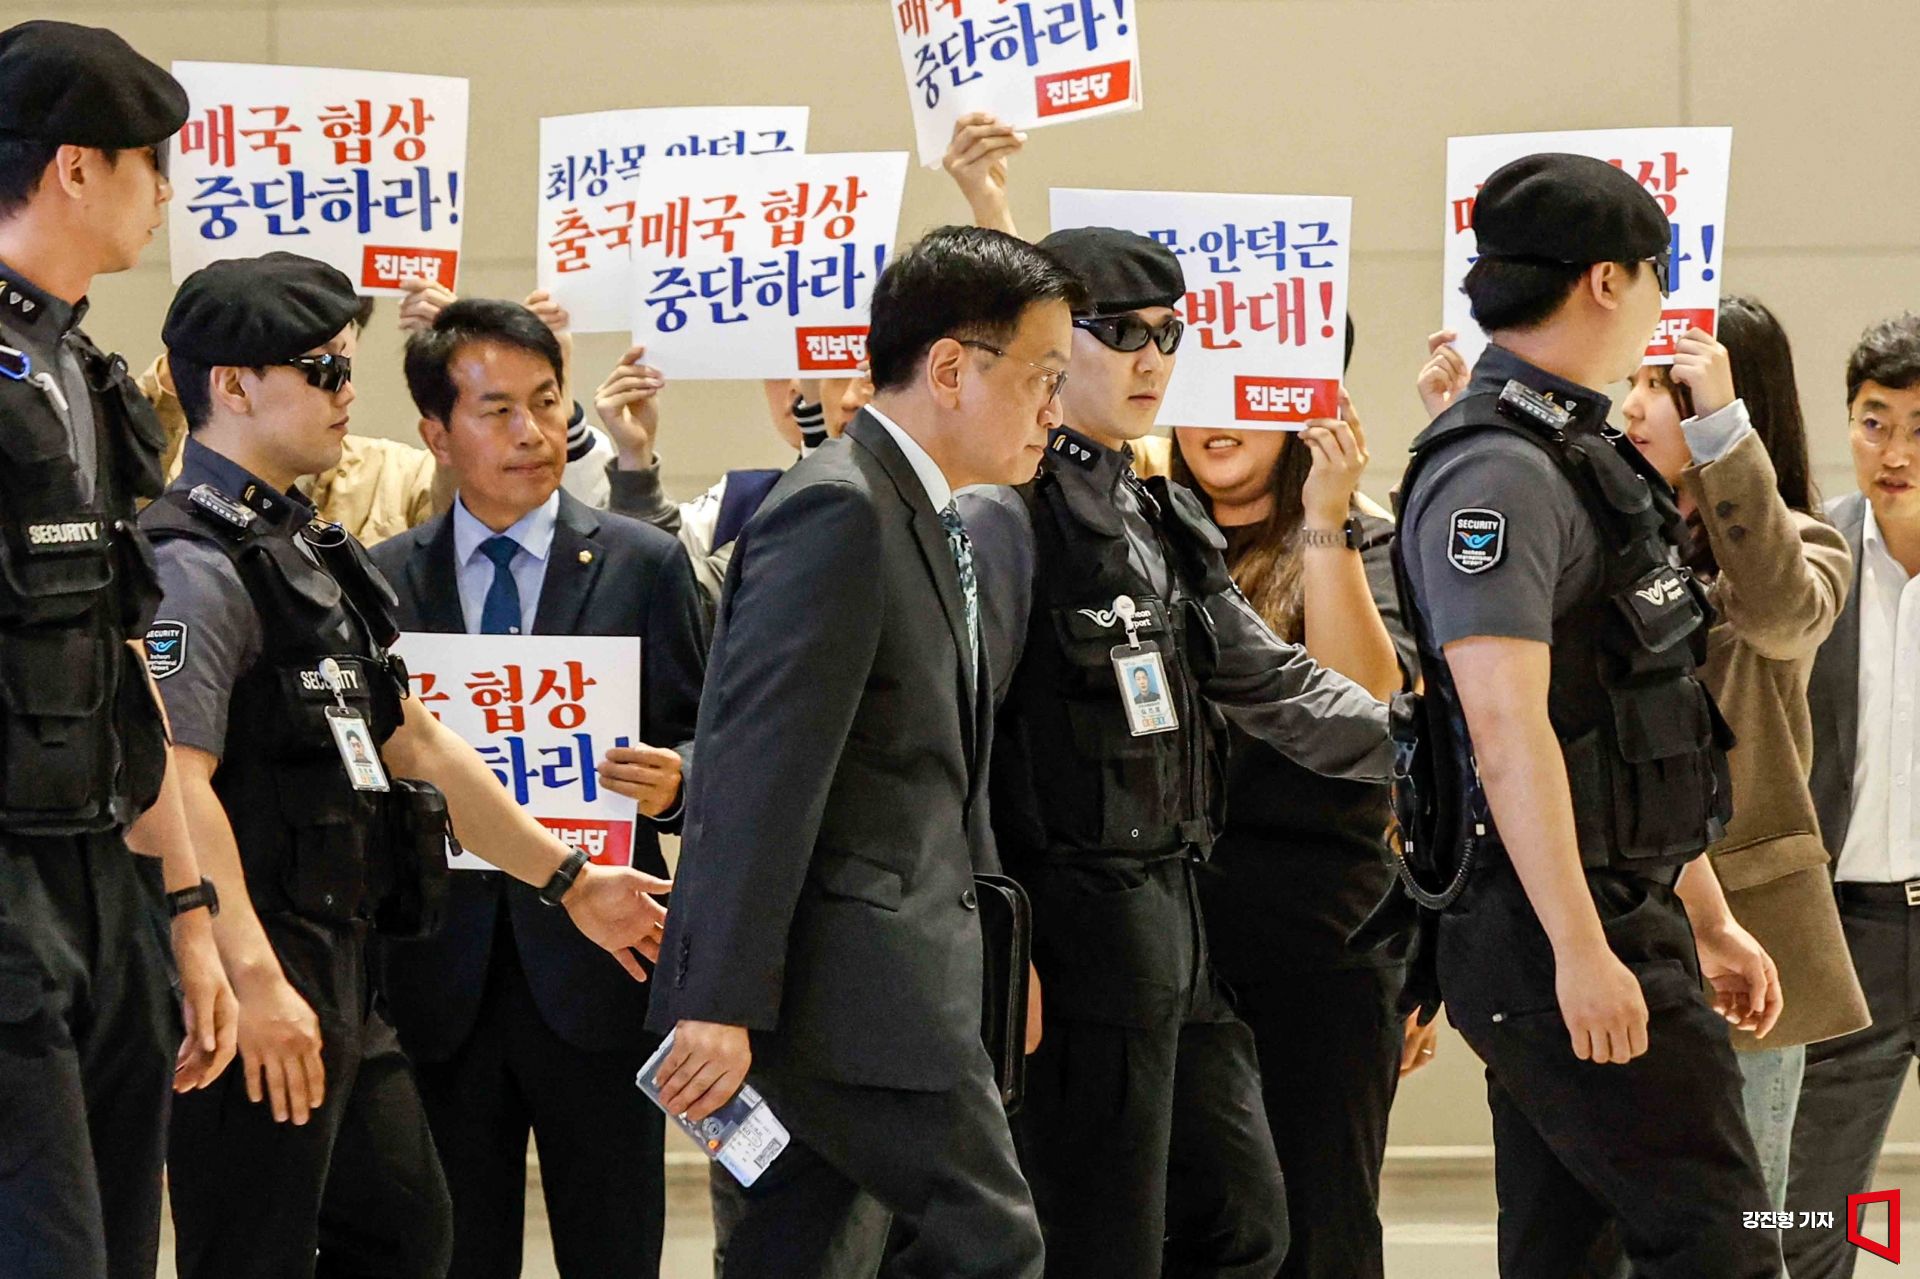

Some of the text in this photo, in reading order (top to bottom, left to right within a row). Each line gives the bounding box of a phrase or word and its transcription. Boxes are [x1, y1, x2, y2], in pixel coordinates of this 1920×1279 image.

[914, 0, 1128, 109] 중단하라!
[1046, 72, 1112, 106] 진보당
[179, 97, 435, 168] 매국 협상
[187, 166, 459, 240] 중단하라!
[640, 176, 868, 259] 매국 협상
[1245, 385, 1315, 415] 진보당
[28, 522, 98, 545] SECURITY
[1457, 519, 1499, 530] SECURITY
[464, 661, 597, 734] 협상
